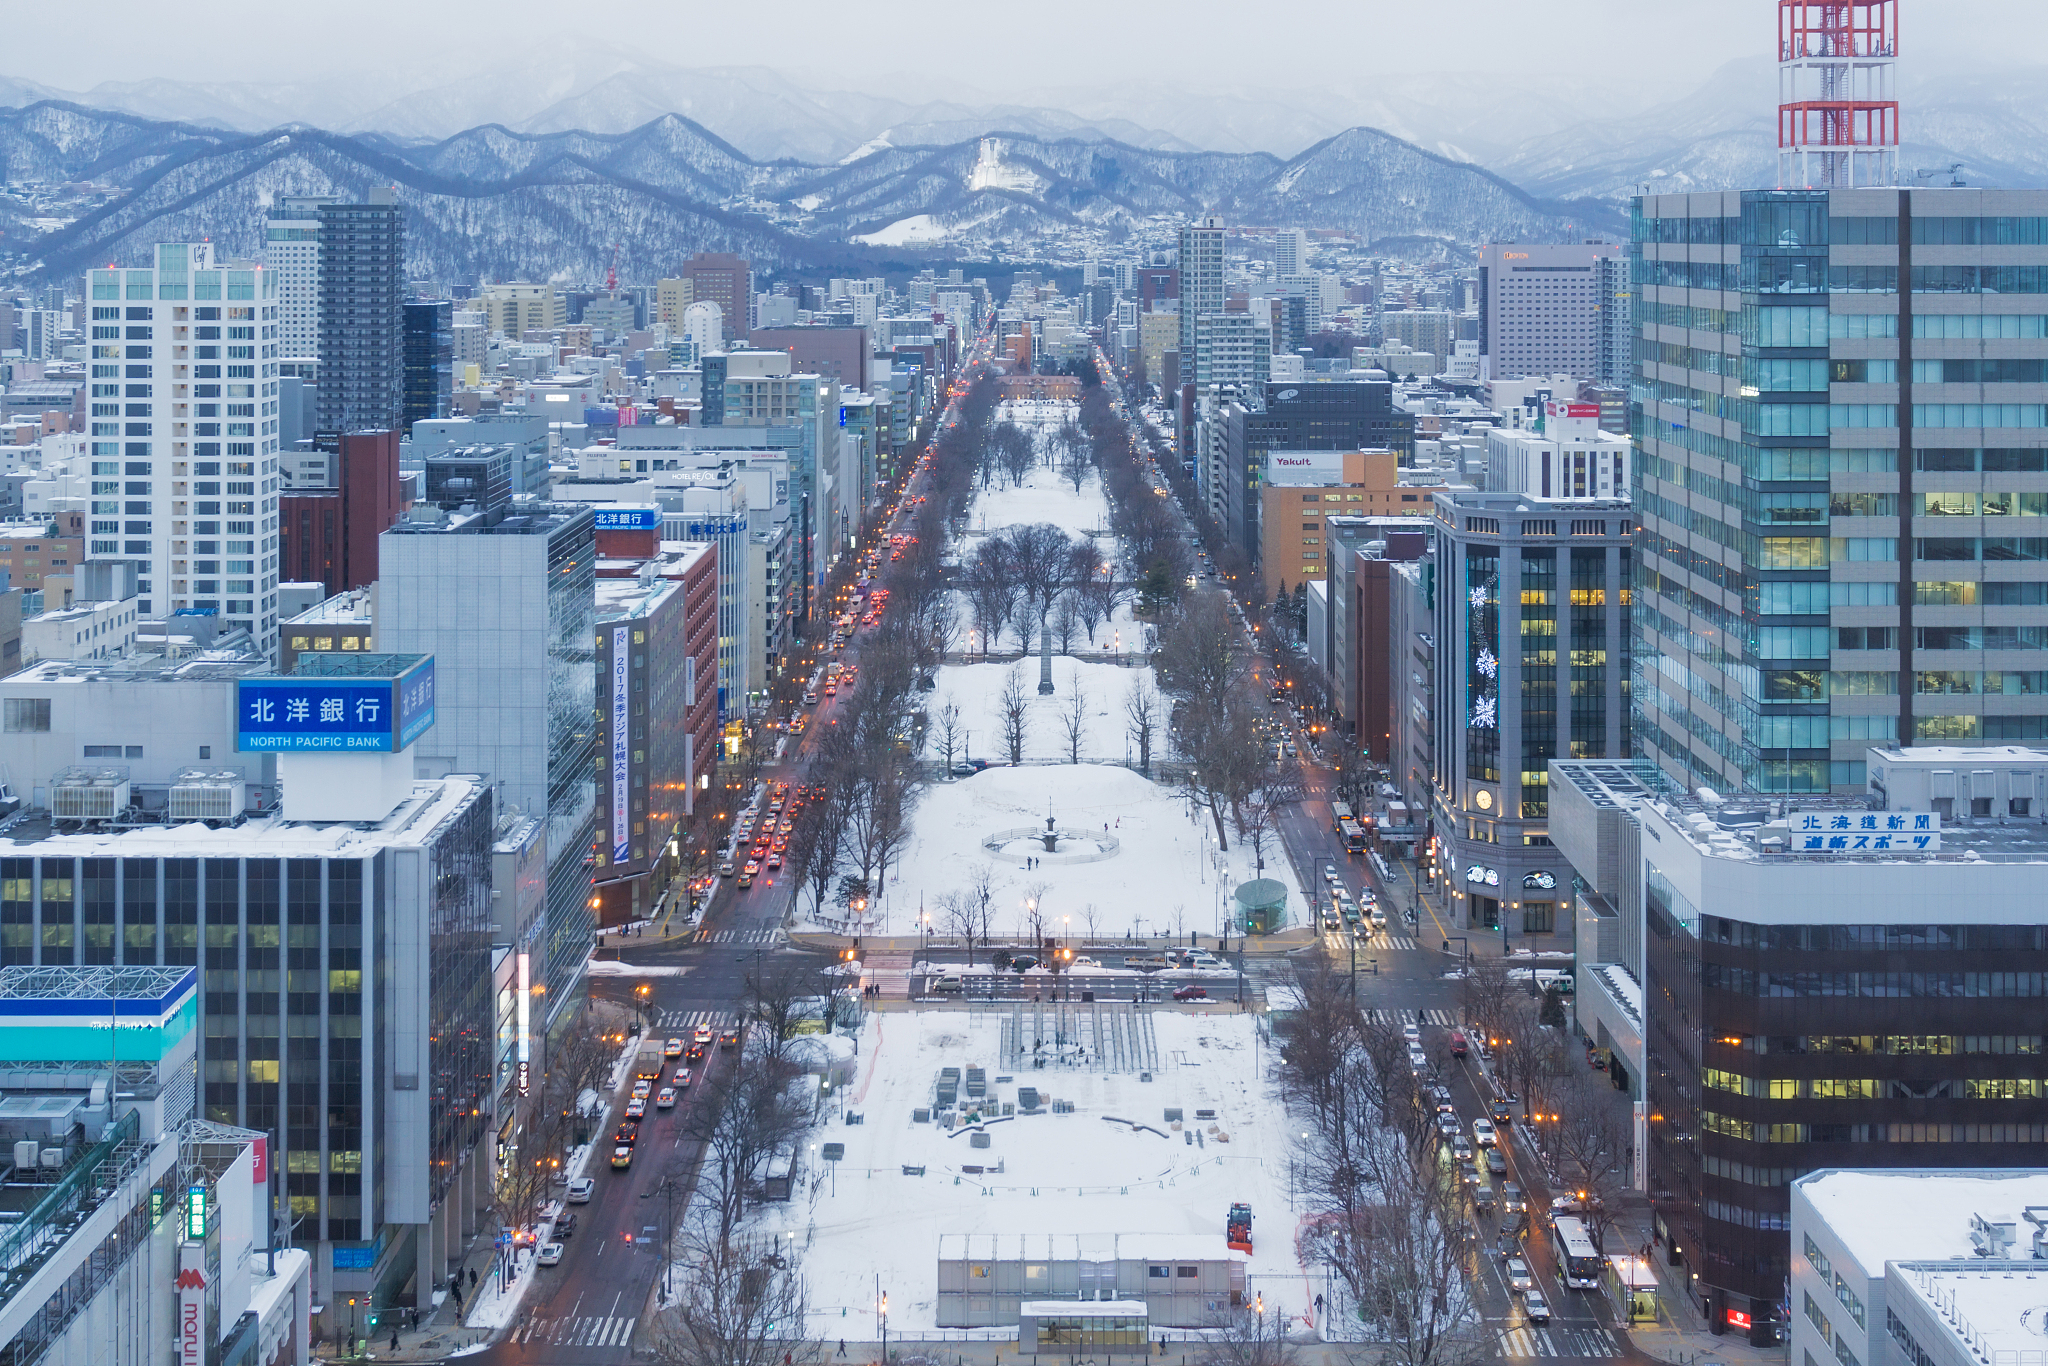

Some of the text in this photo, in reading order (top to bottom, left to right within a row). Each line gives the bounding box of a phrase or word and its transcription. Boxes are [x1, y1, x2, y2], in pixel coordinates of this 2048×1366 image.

[680, 383, 687, 391] P
[1540, 394, 1549, 402] P
[1277, 458, 1312, 466] Yakult
[692, 470, 716, 482] RESOL
[596, 513, 642, 525] 北洋銀行
[250, 698, 380, 723] 北洋銀行
[250, 736, 381, 747] NORTH PACIFIC BANK
[1802, 815, 1930, 830] 北海道新聞
[1803, 834, 1931, 849] 道新スポーツ
